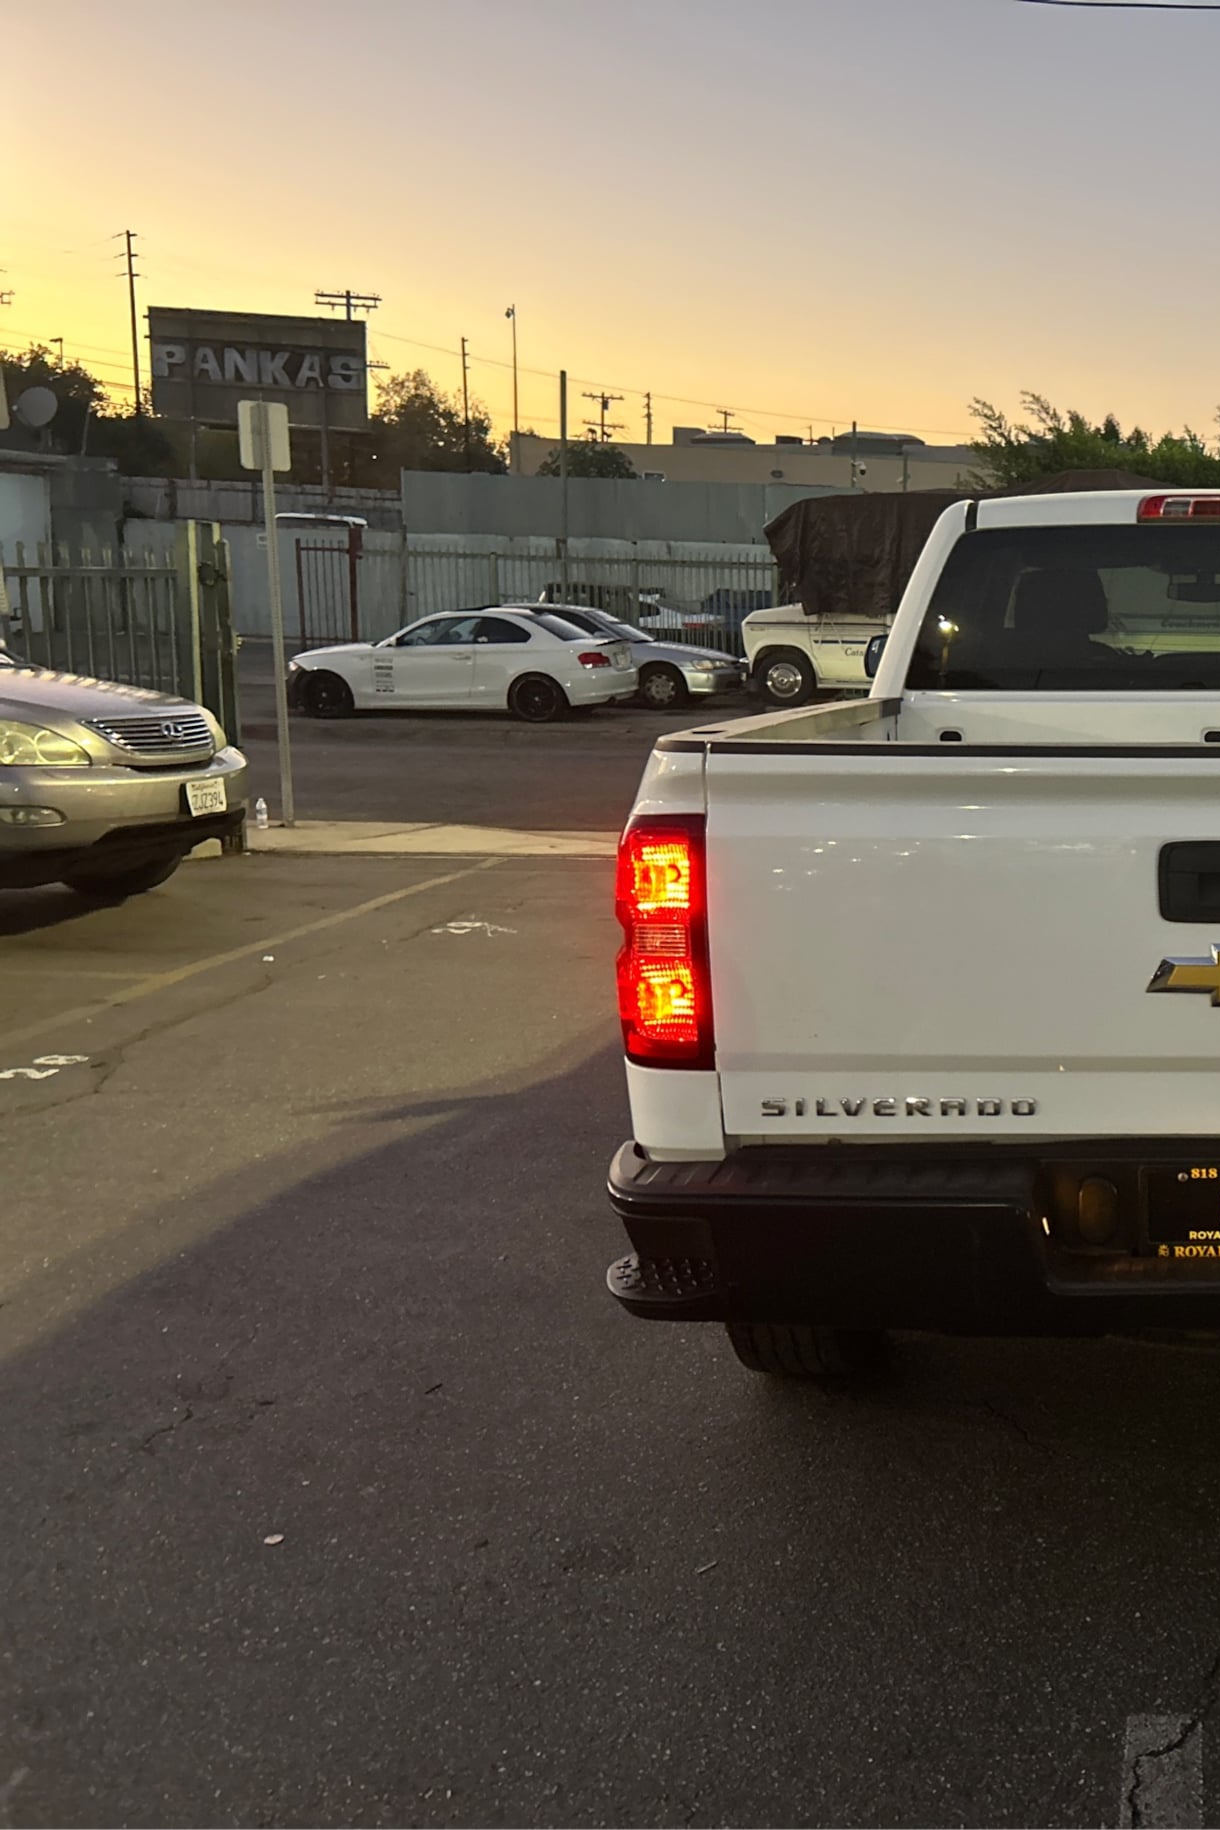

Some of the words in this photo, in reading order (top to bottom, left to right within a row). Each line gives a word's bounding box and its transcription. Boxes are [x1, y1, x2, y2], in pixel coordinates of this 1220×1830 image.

[152, 343, 363, 390] PANKAS
[760, 1097, 1037, 1117] SILVERADO
[1191, 1168, 1218, 1179] 818
